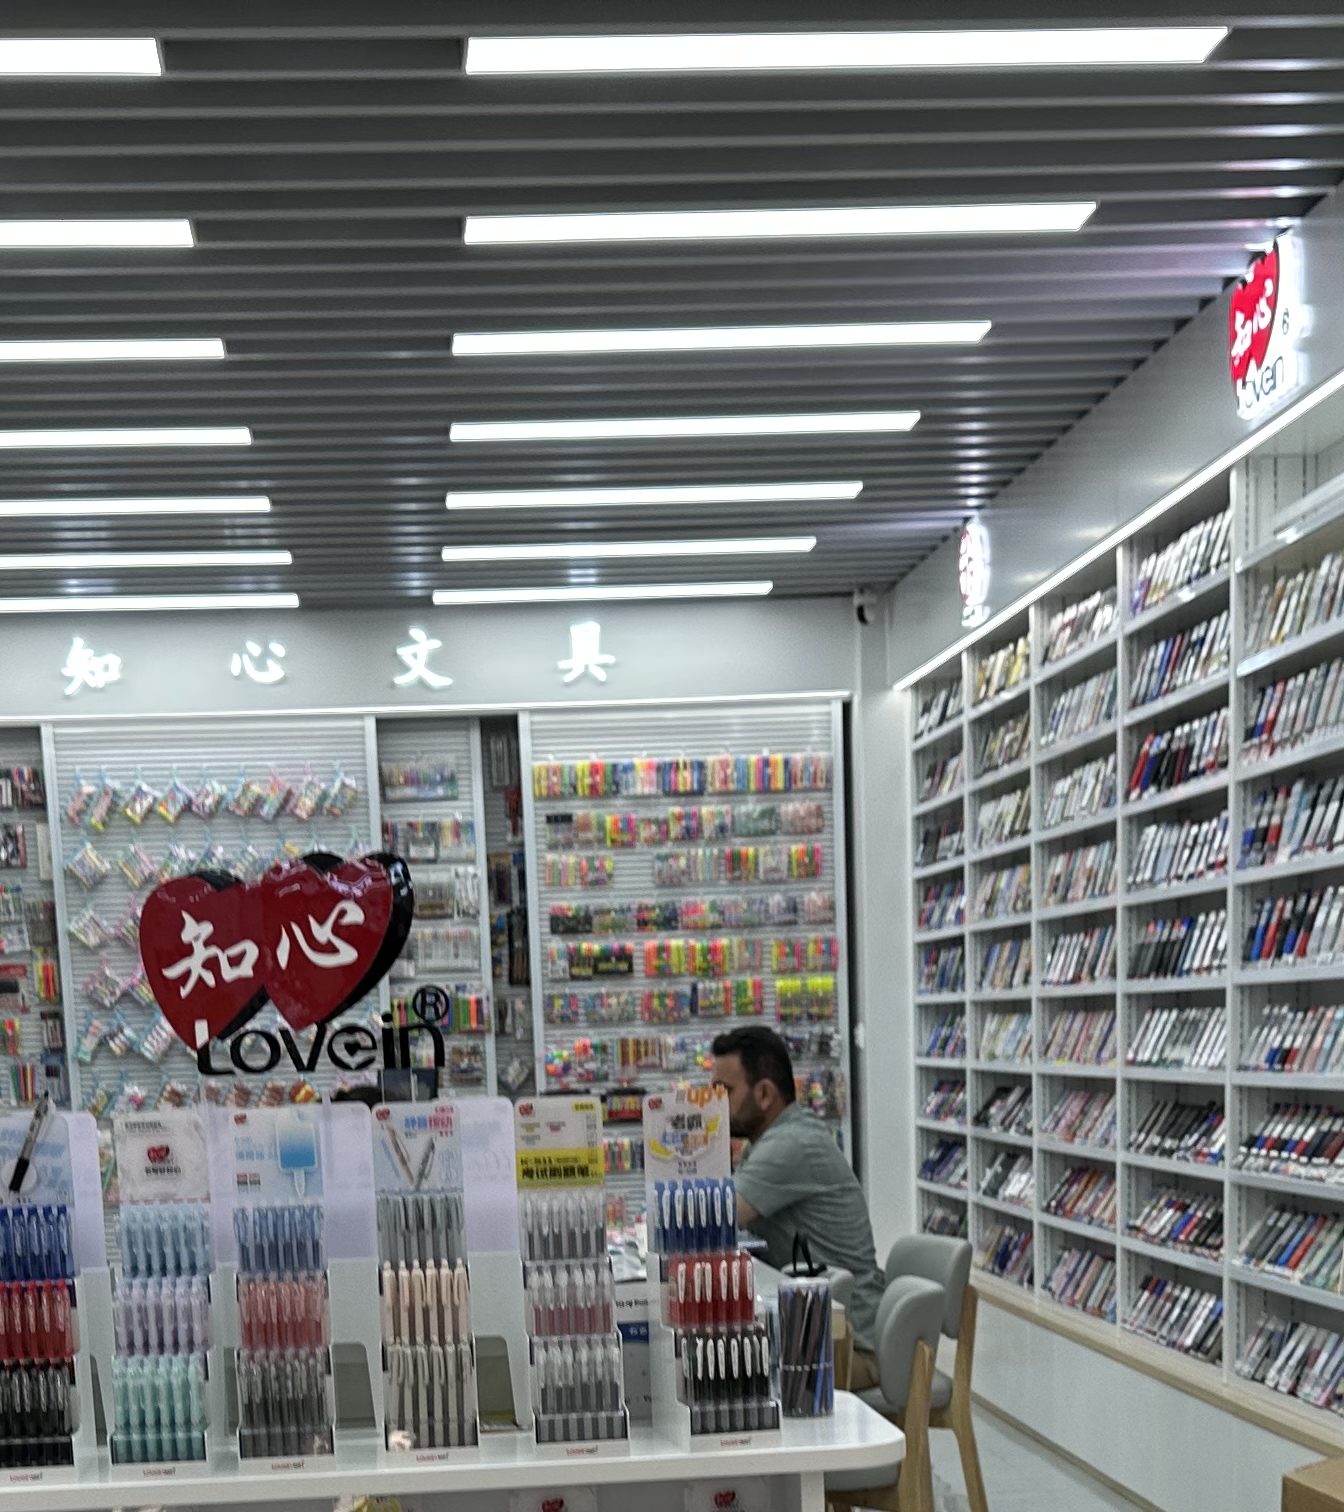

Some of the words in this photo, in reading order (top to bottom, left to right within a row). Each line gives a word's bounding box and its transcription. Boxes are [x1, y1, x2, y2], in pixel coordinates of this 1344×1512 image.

[60, 619, 617, 697] 知心文具
[162, 900, 364, 998] 知心
